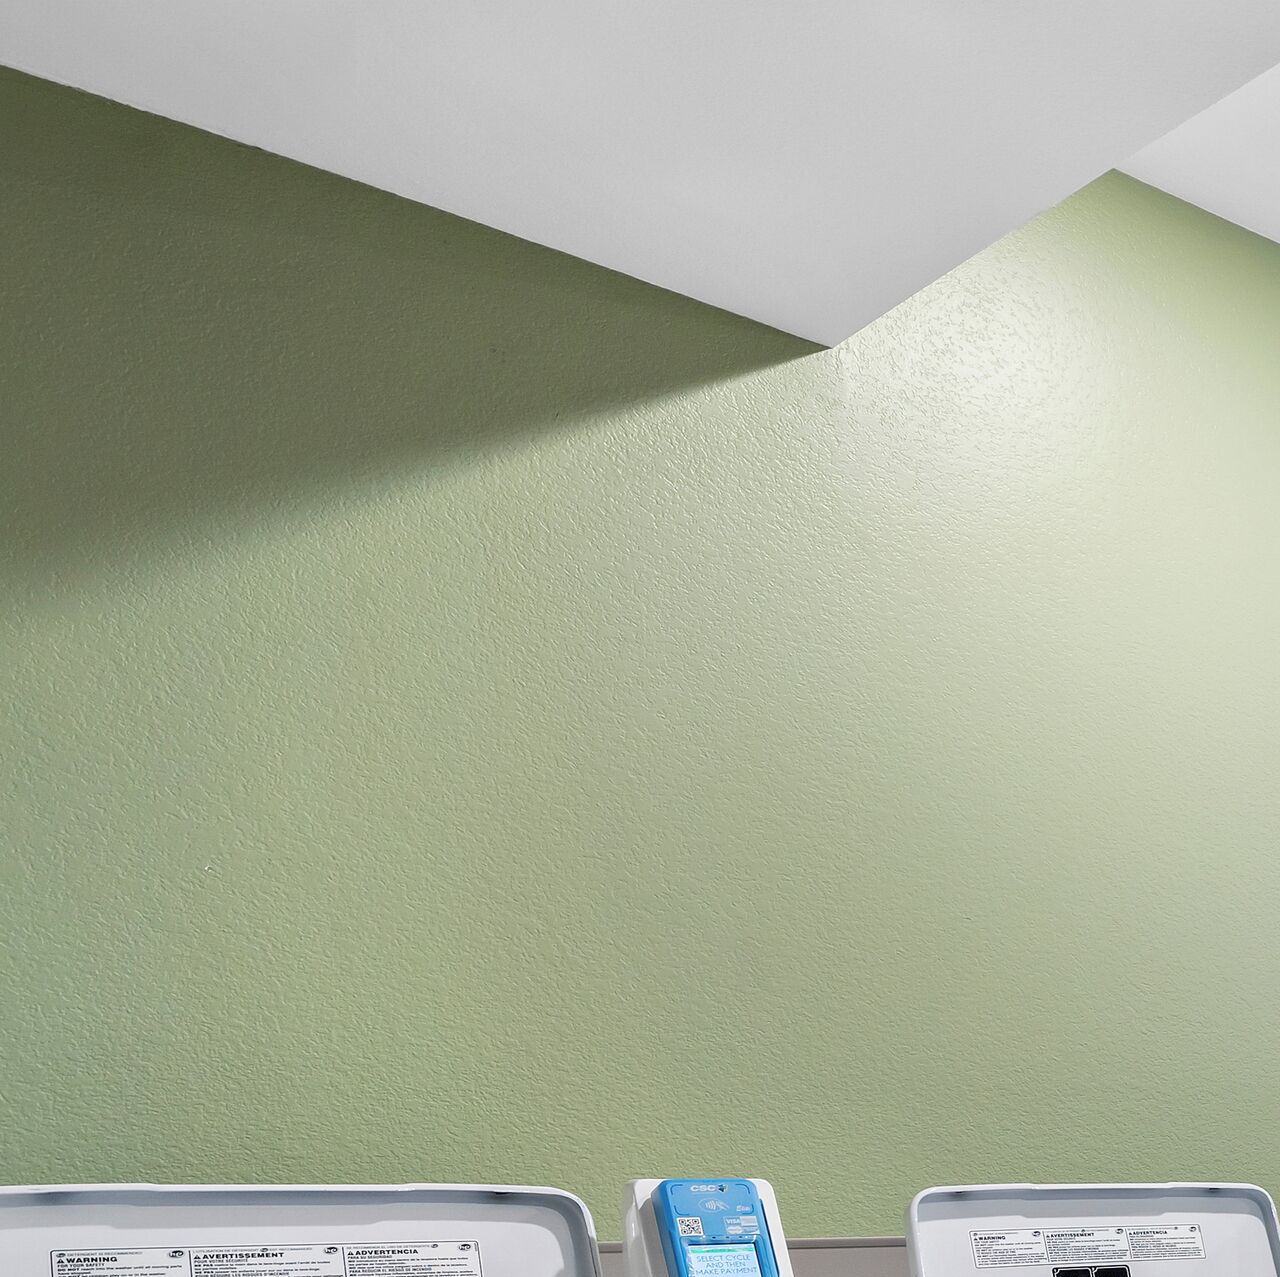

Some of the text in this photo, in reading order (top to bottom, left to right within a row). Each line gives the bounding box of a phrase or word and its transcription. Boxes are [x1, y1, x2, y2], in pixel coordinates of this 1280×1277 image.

[66, 1256, 118, 1264] WARNING
[696, 1254, 724, 1262] SELECT
[706, 1261, 724, 1269] AND
